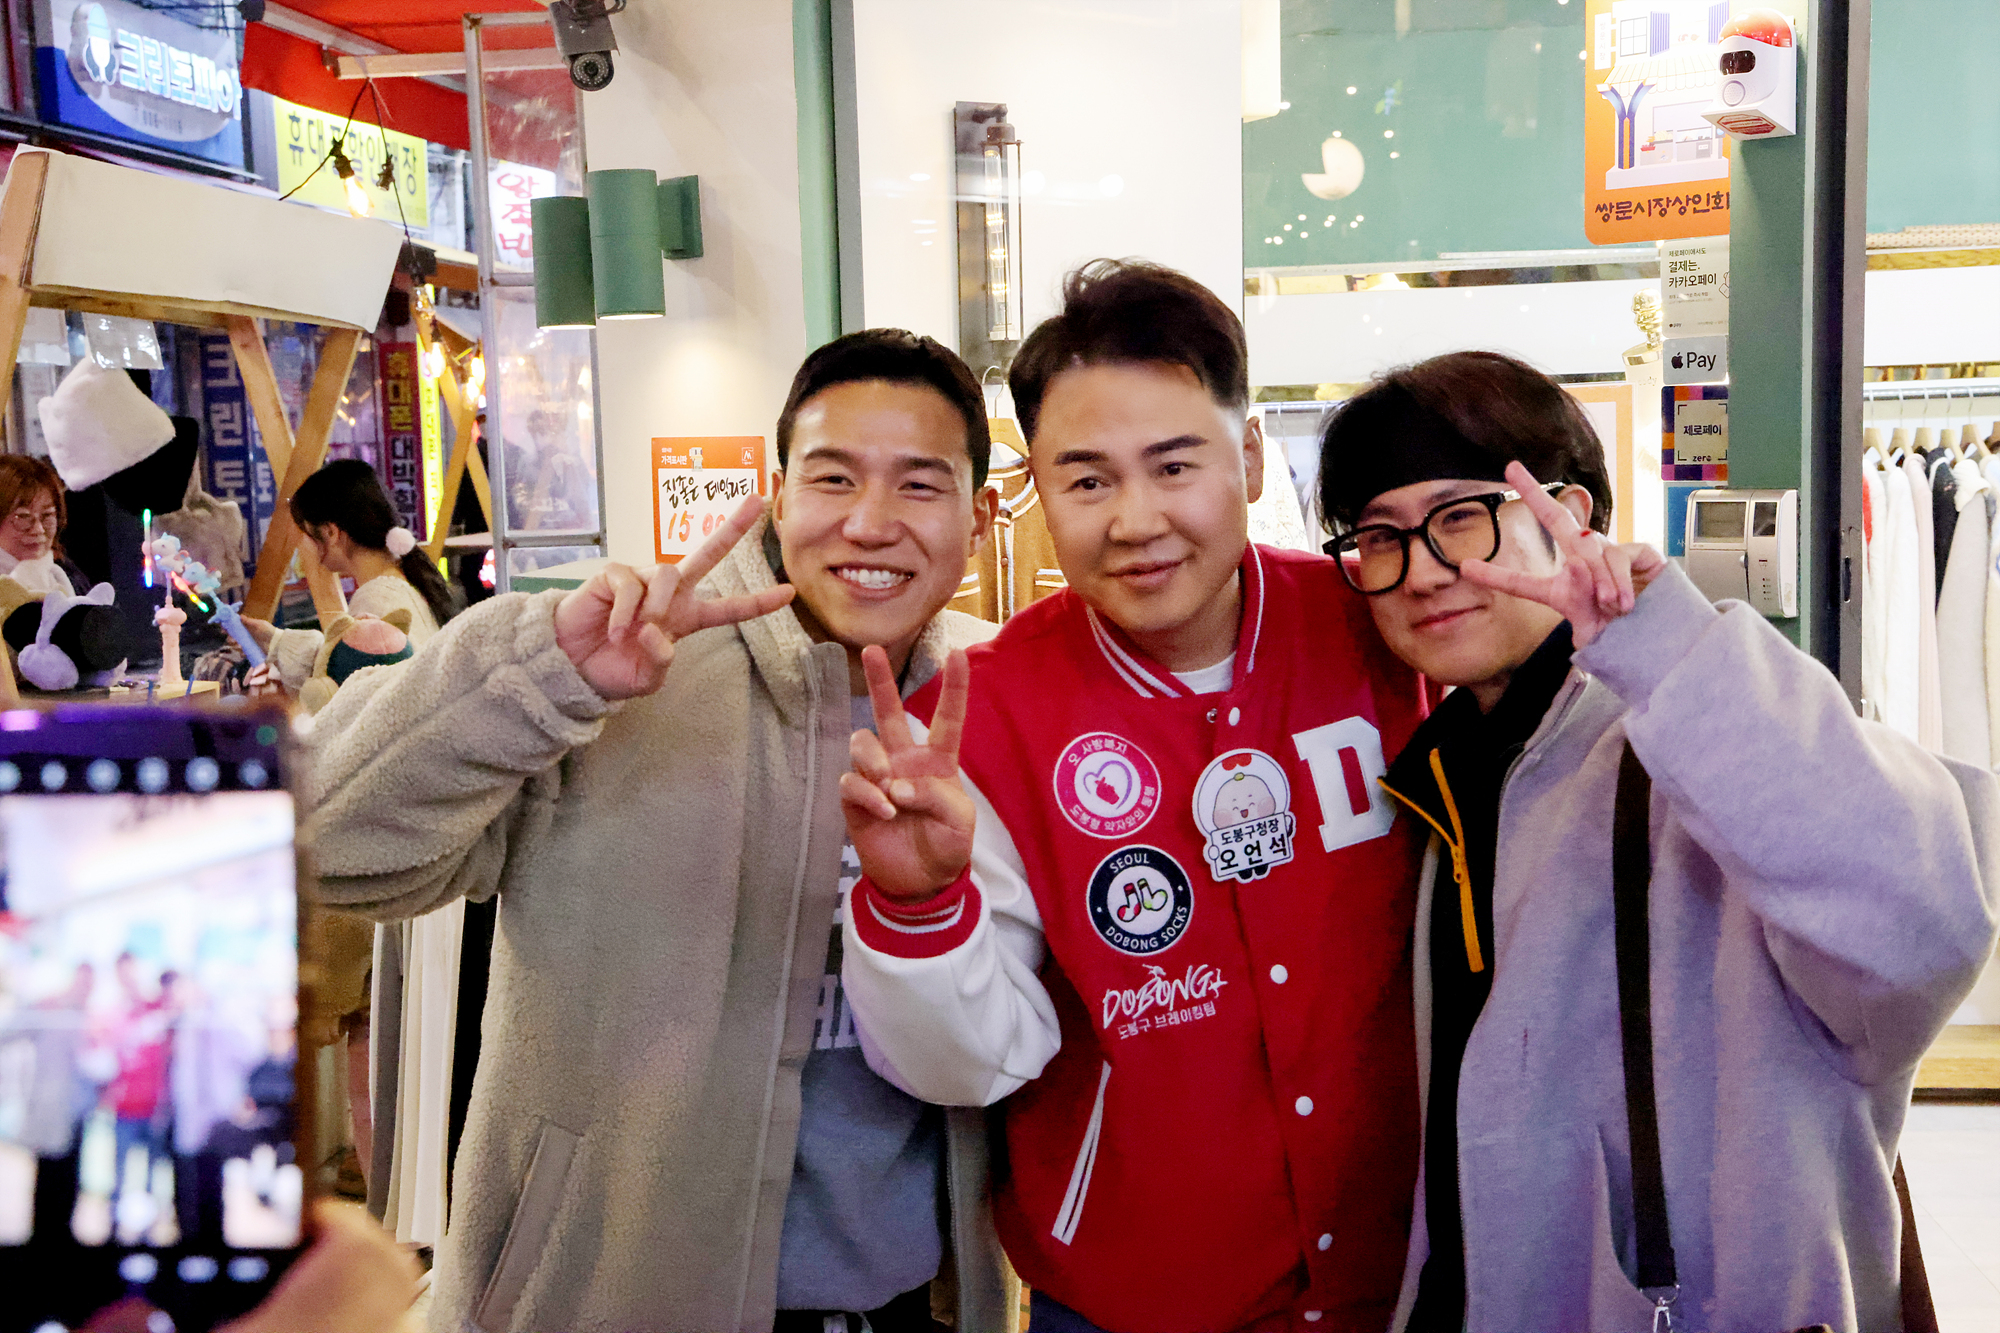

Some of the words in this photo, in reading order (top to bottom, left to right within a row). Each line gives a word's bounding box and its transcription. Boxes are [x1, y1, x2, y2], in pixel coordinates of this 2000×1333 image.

[1595, 190, 1730, 223] 쌍문시장상인회
[1669, 260, 1701, 274] 결제는.
[1669, 273, 1717, 289] 카카오페이
[1686, 351, 1717, 371] Pay
[1683, 424, 1722, 436] 제로페이
[206, 344, 250, 562] 크린토
[661, 454, 688, 466] 가격표시판
[1692, 455, 1712, 463] zero
[1292, 715, 1397, 853] D
[1221, 818, 1279, 846] 도봉구청장
[1109, 852, 1151, 874] SEOUL
[1105, 926, 1159, 951] DOBONG
[1160, 905, 1188, 942] SOCKS
[1117, 1019, 1152, 1041] 도봉구
[1154, 1000, 1217, 1029] 브레이킹팀
